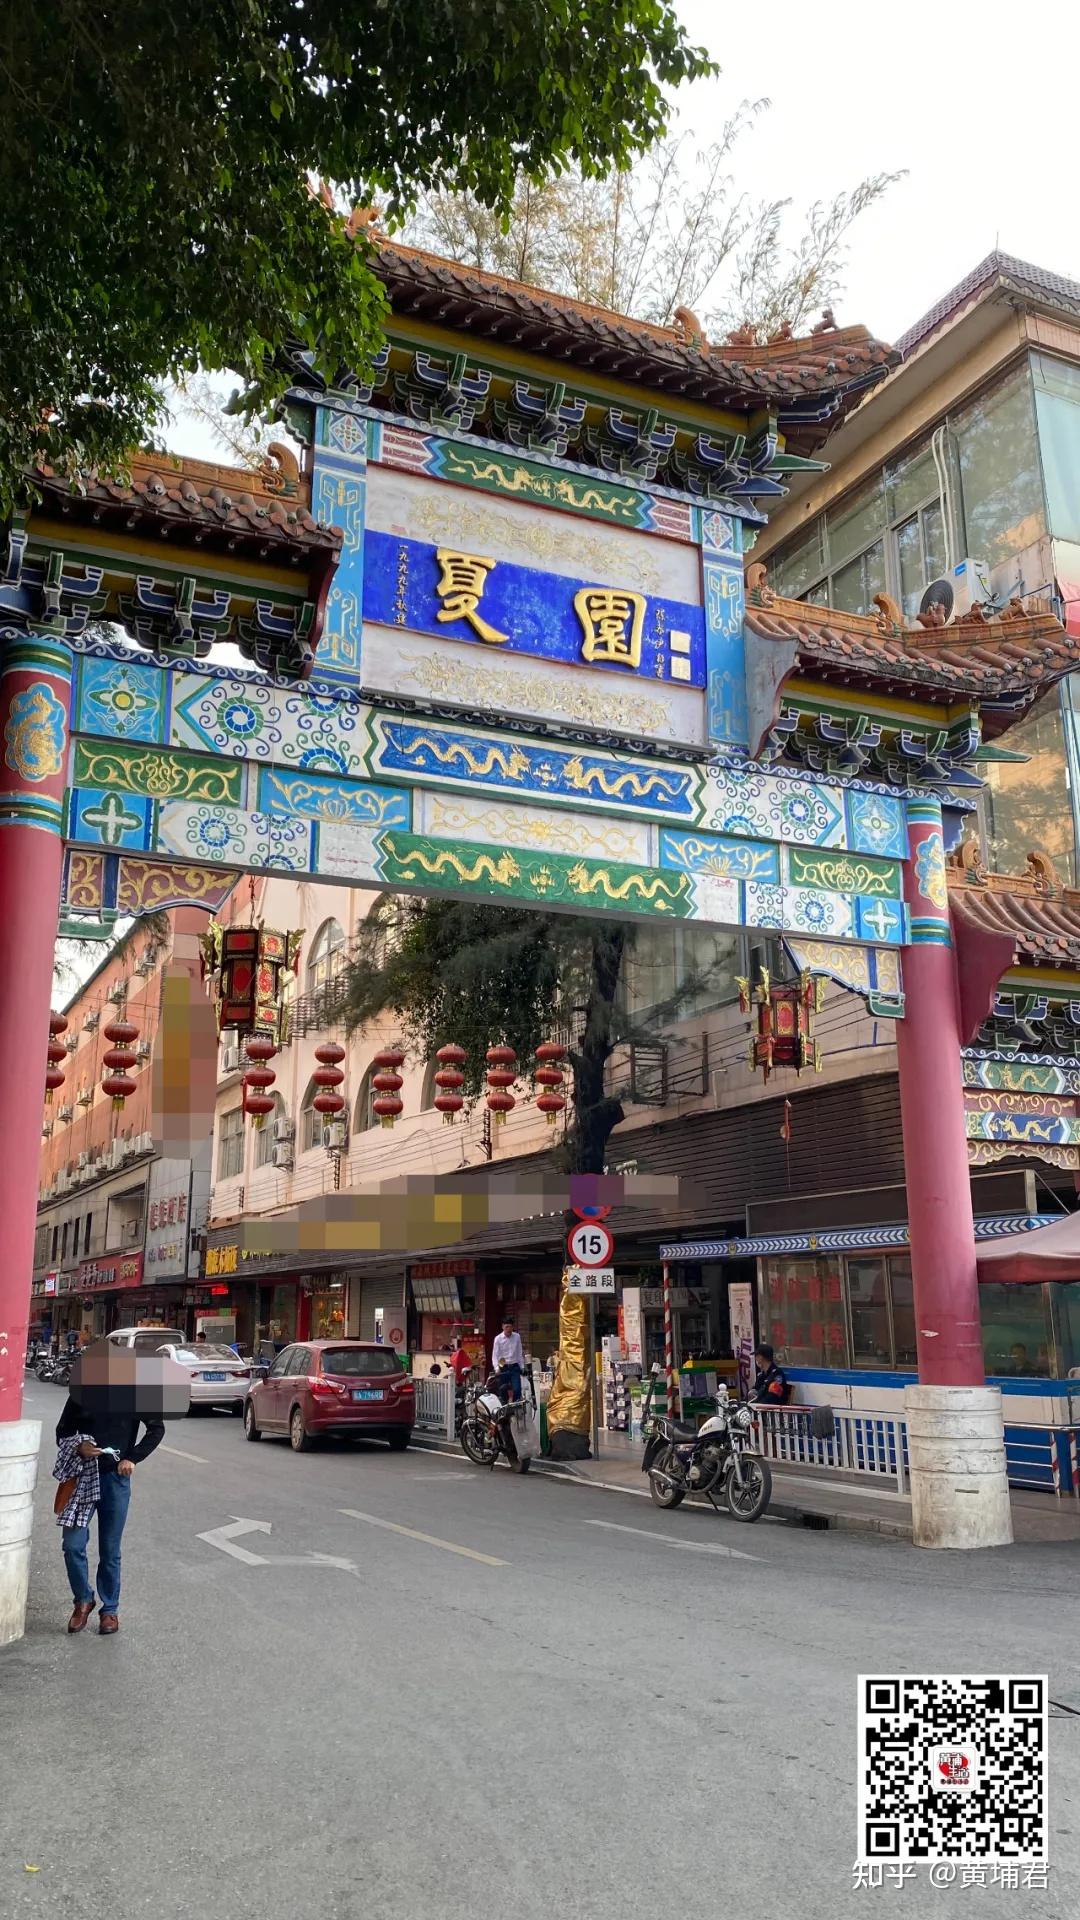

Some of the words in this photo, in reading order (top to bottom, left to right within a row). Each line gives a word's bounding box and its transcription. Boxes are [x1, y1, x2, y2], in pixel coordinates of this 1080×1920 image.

[577, 1234, 602, 1255] 15
[570, 1274, 613, 1288] 全路段
